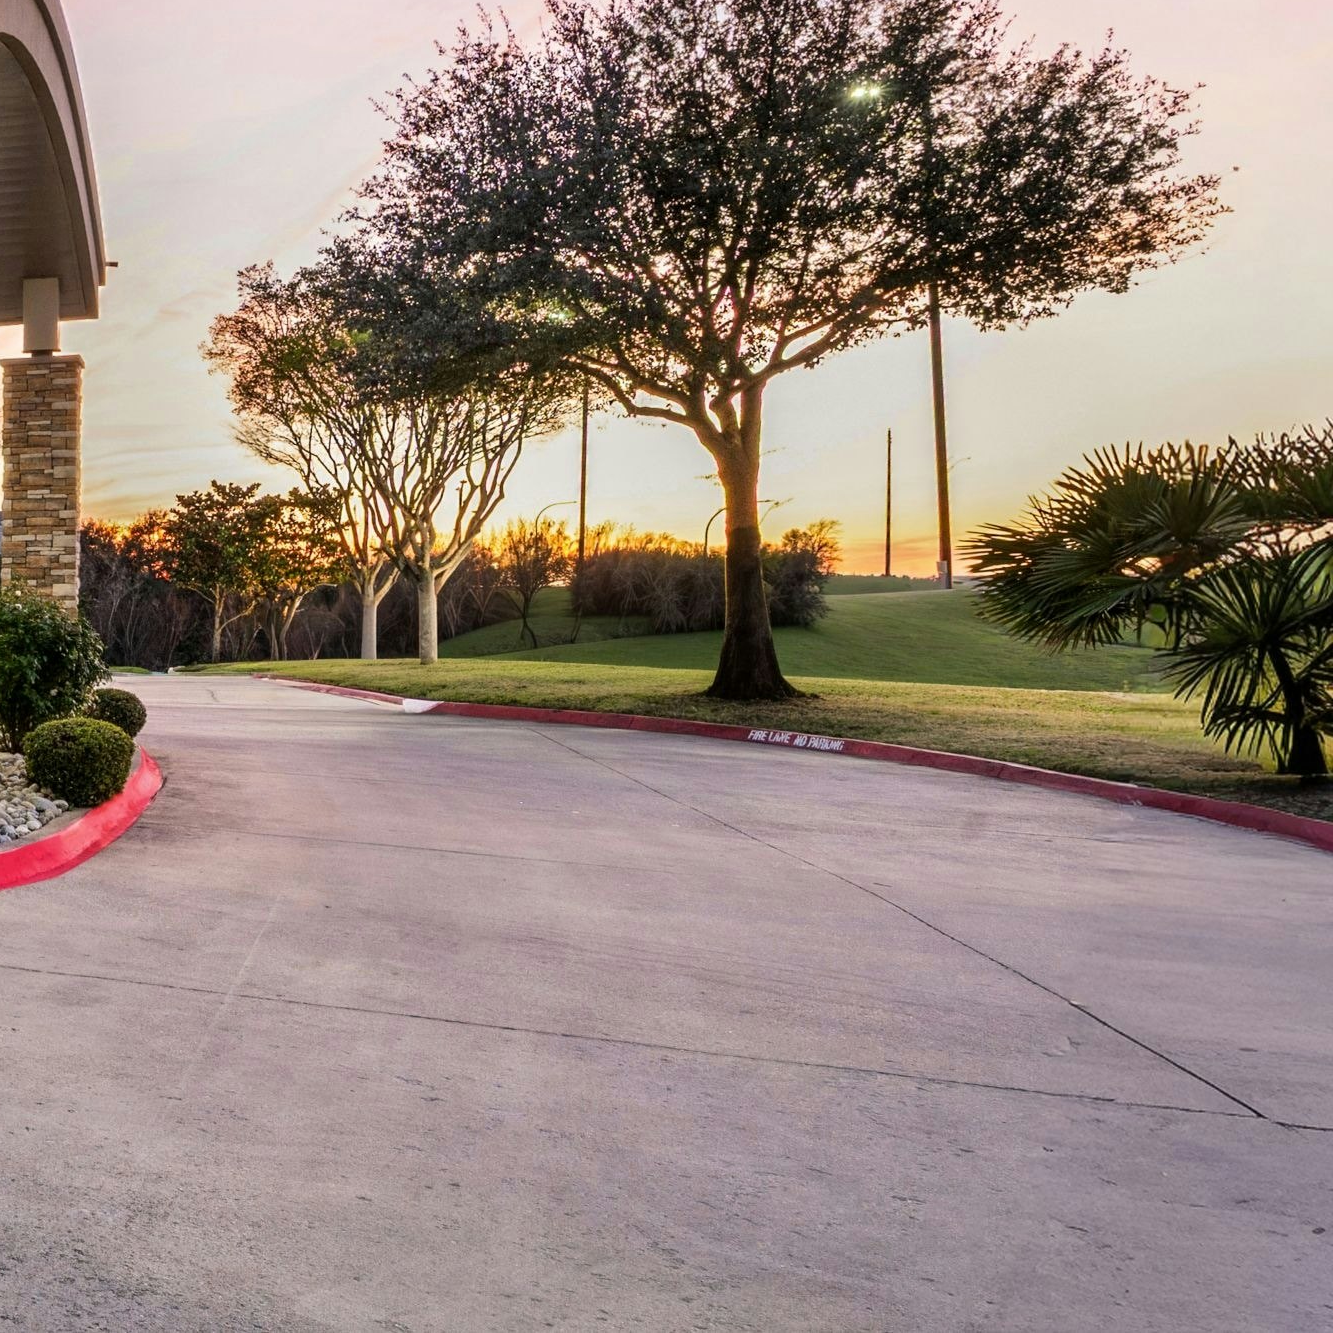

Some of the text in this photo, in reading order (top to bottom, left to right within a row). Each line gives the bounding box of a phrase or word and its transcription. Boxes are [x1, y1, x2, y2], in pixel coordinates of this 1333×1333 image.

[748, 730, 845, 750] FIRE LANE NO PARKING
